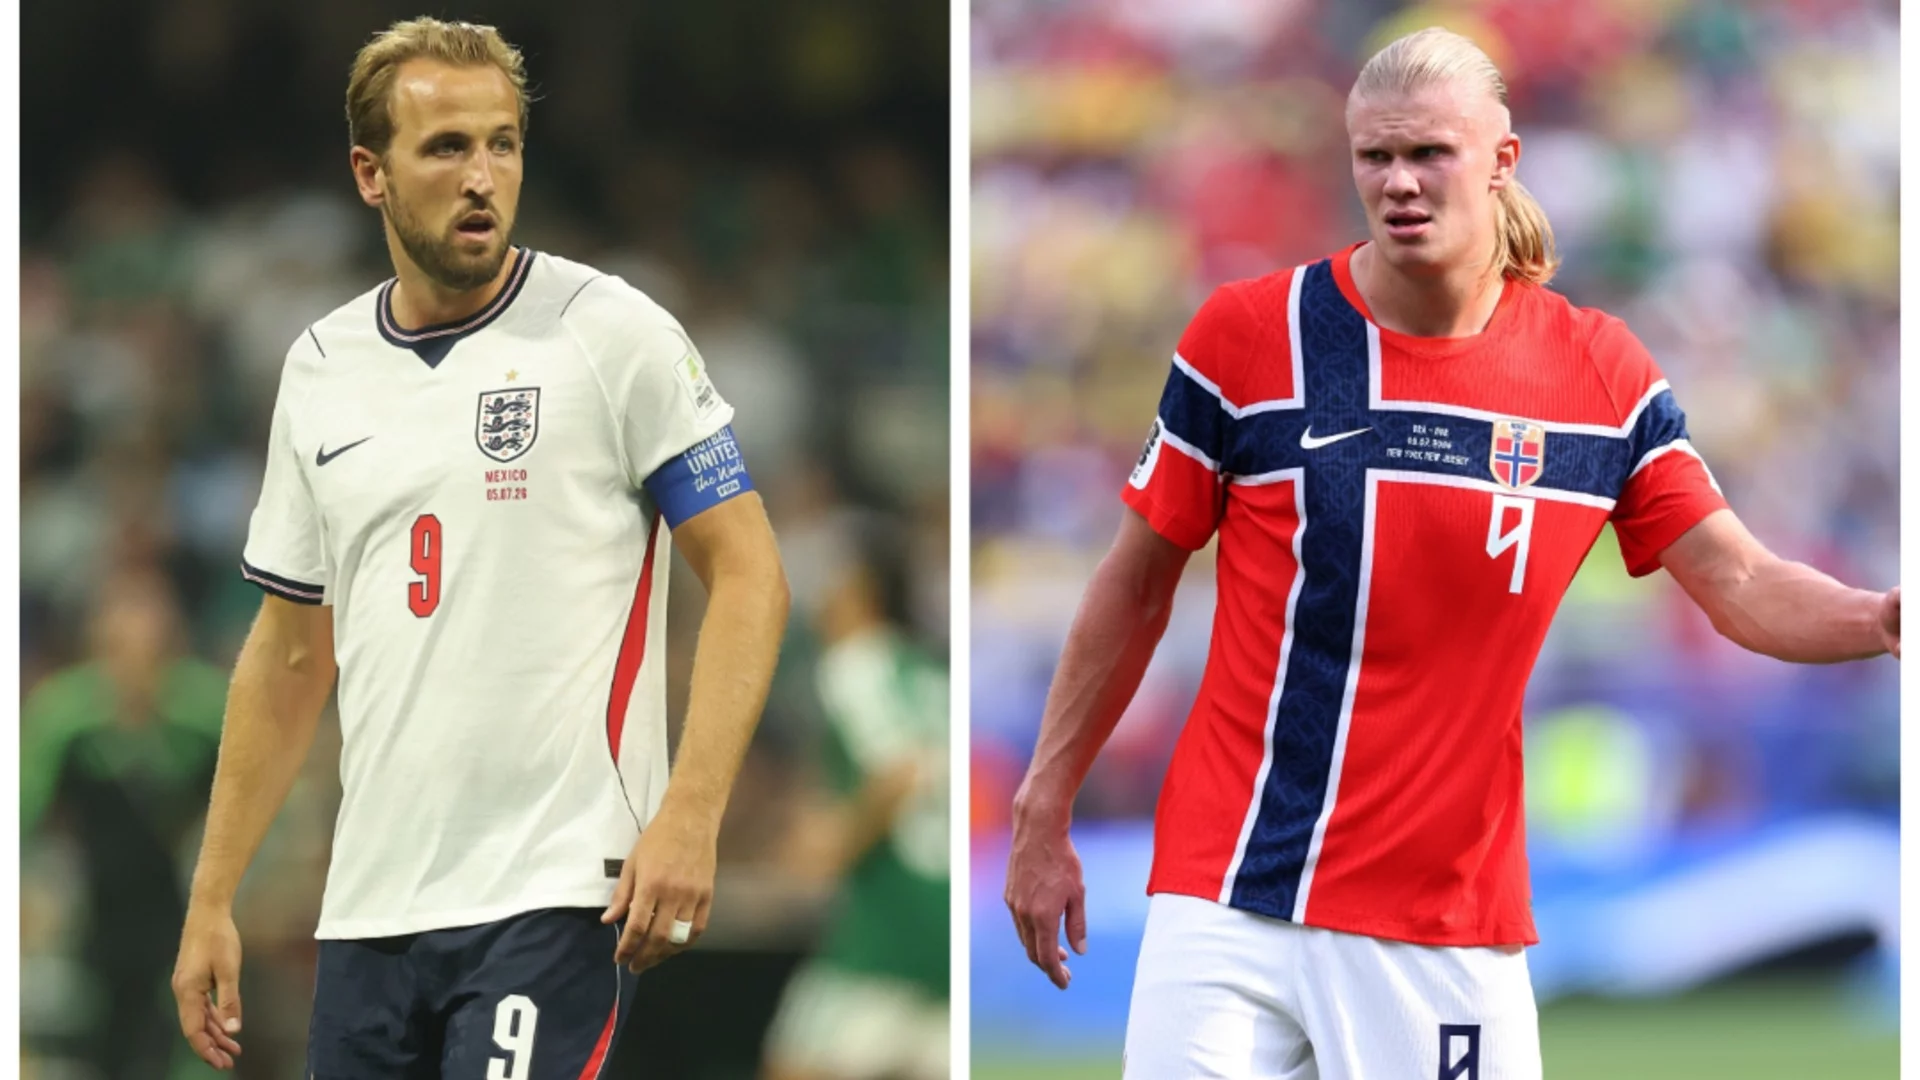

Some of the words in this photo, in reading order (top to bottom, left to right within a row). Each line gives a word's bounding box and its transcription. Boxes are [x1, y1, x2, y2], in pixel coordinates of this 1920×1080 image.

[687, 440, 740, 475] UNITES
[1386, 448, 1403, 458] NEW
[1424, 451, 1441, 462] NEW
[1441, 454, 1470, 466] JERSEY
[485, 468, 528, 483] MEXICO
[692, 473, 717, 494] the
[486, 487, 528, 501] 05.07.26
[1485, 493, 1536, 595] 9
[407, 513, 442, 618] 9
[486, 994, 538, 1080] 9
